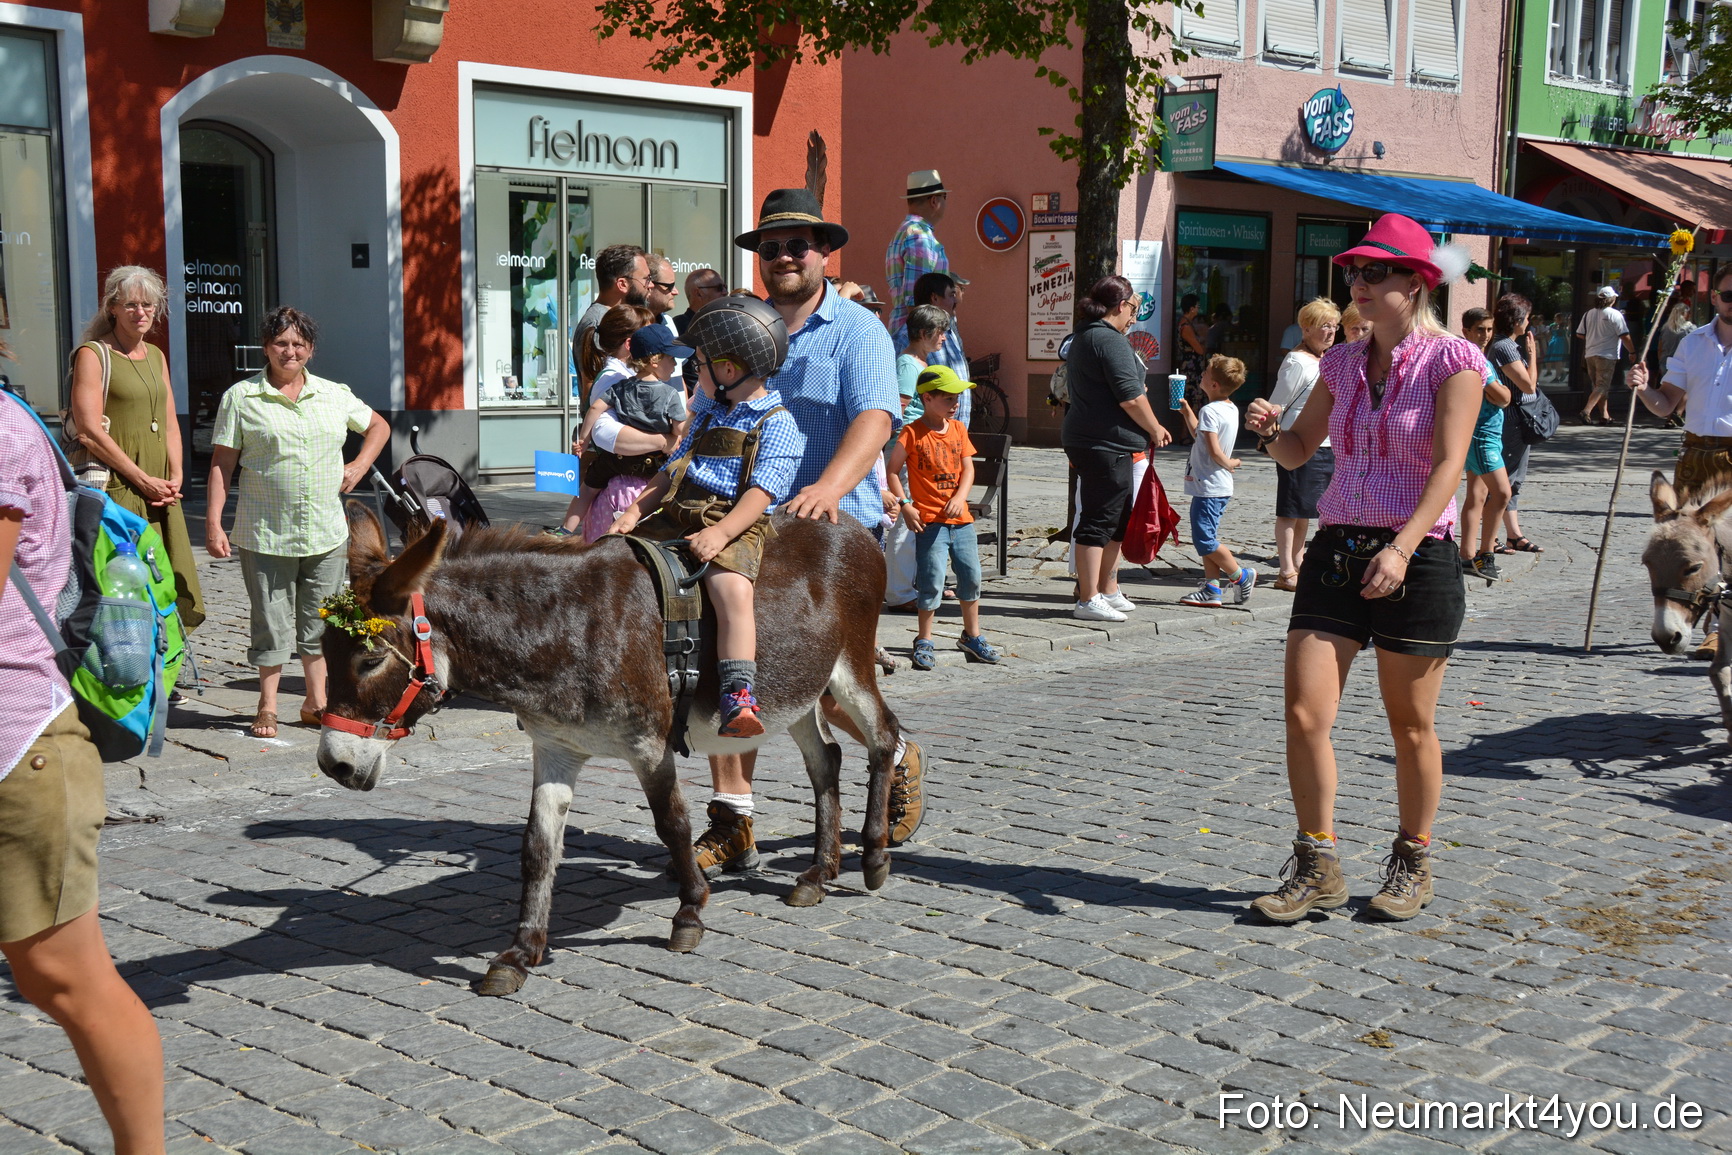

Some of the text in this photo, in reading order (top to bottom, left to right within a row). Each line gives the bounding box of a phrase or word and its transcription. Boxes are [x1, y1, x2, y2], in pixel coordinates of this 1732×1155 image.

[1169, 105, 1191, 122] vom
[1303, 94, 1332, 119] vom
[1176, 109, 1208, 134] FASS
[1311, 108, 1354, 144] FASS
[1172, 147, 1204, 155] PROBIEREN
[1033, 213, 1078, 225] Bockwirtsgass
[1178, 220, 1265, 245] Spirituosen Whisky
[1309, 233, 1342, 248] Feinkost
[184, 258, 241, 276] elmann
[496, 250, 546, 268] ielmann
[580, 253, 596, 270] fie
[664, 257, 712, 273] elmann
[184, 277, 242, 295] elmann
[1030, 271, 1074, 296] VENEZIA
[186, 296, 243, 314] elmann
[1137, 300, 1155, 317] ASS
